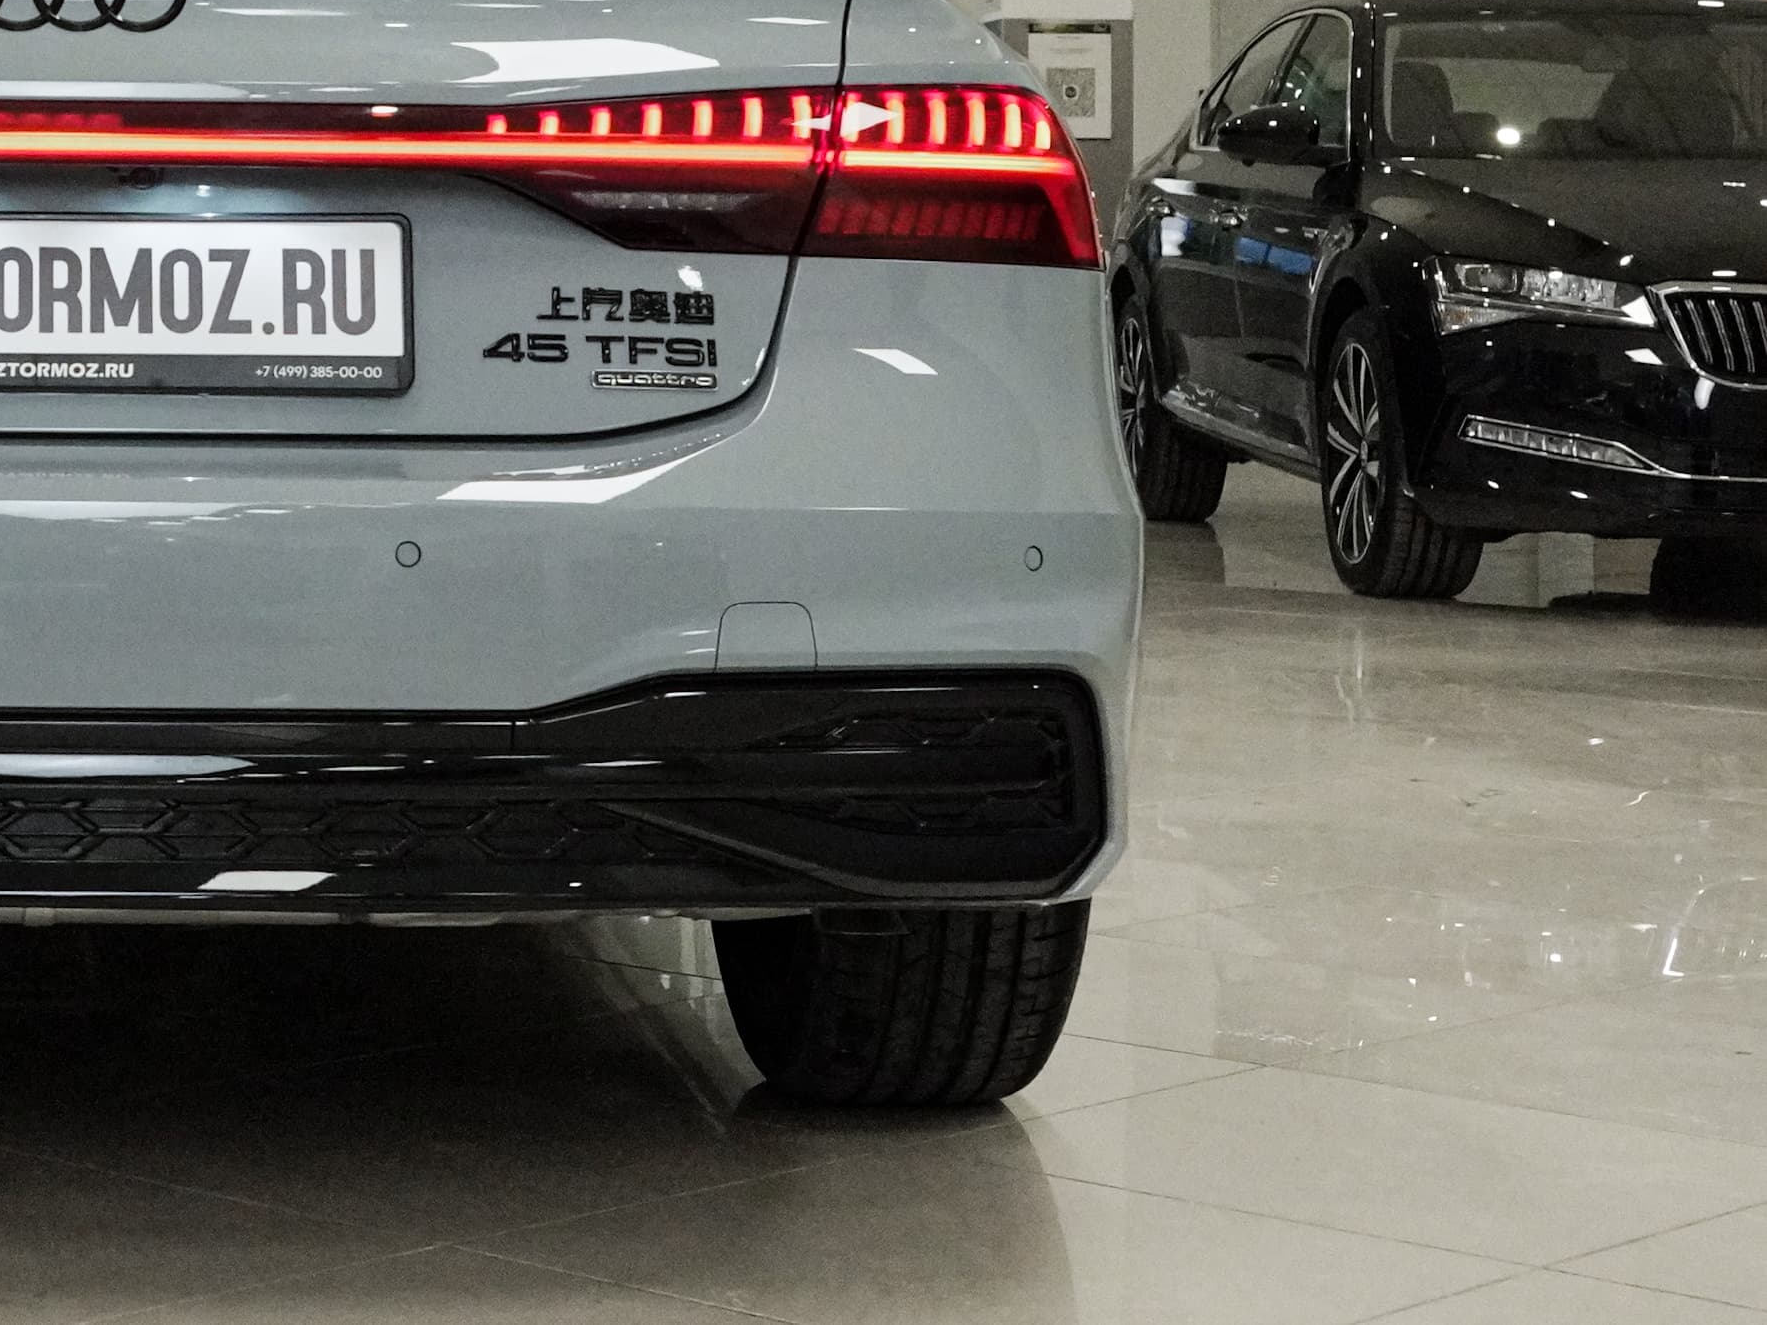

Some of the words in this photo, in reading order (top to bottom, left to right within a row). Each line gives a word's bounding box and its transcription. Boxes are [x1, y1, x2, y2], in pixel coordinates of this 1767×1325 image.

[483, 333, 569, 363] 45
[585, 335, 717, 367] TFSI
[255, 366, 271, 378] +7
[273, 365, 308, 379] (499)
[309, 365, 383, 379] 385-00-00
[597, 373, 714, 386] quattro
